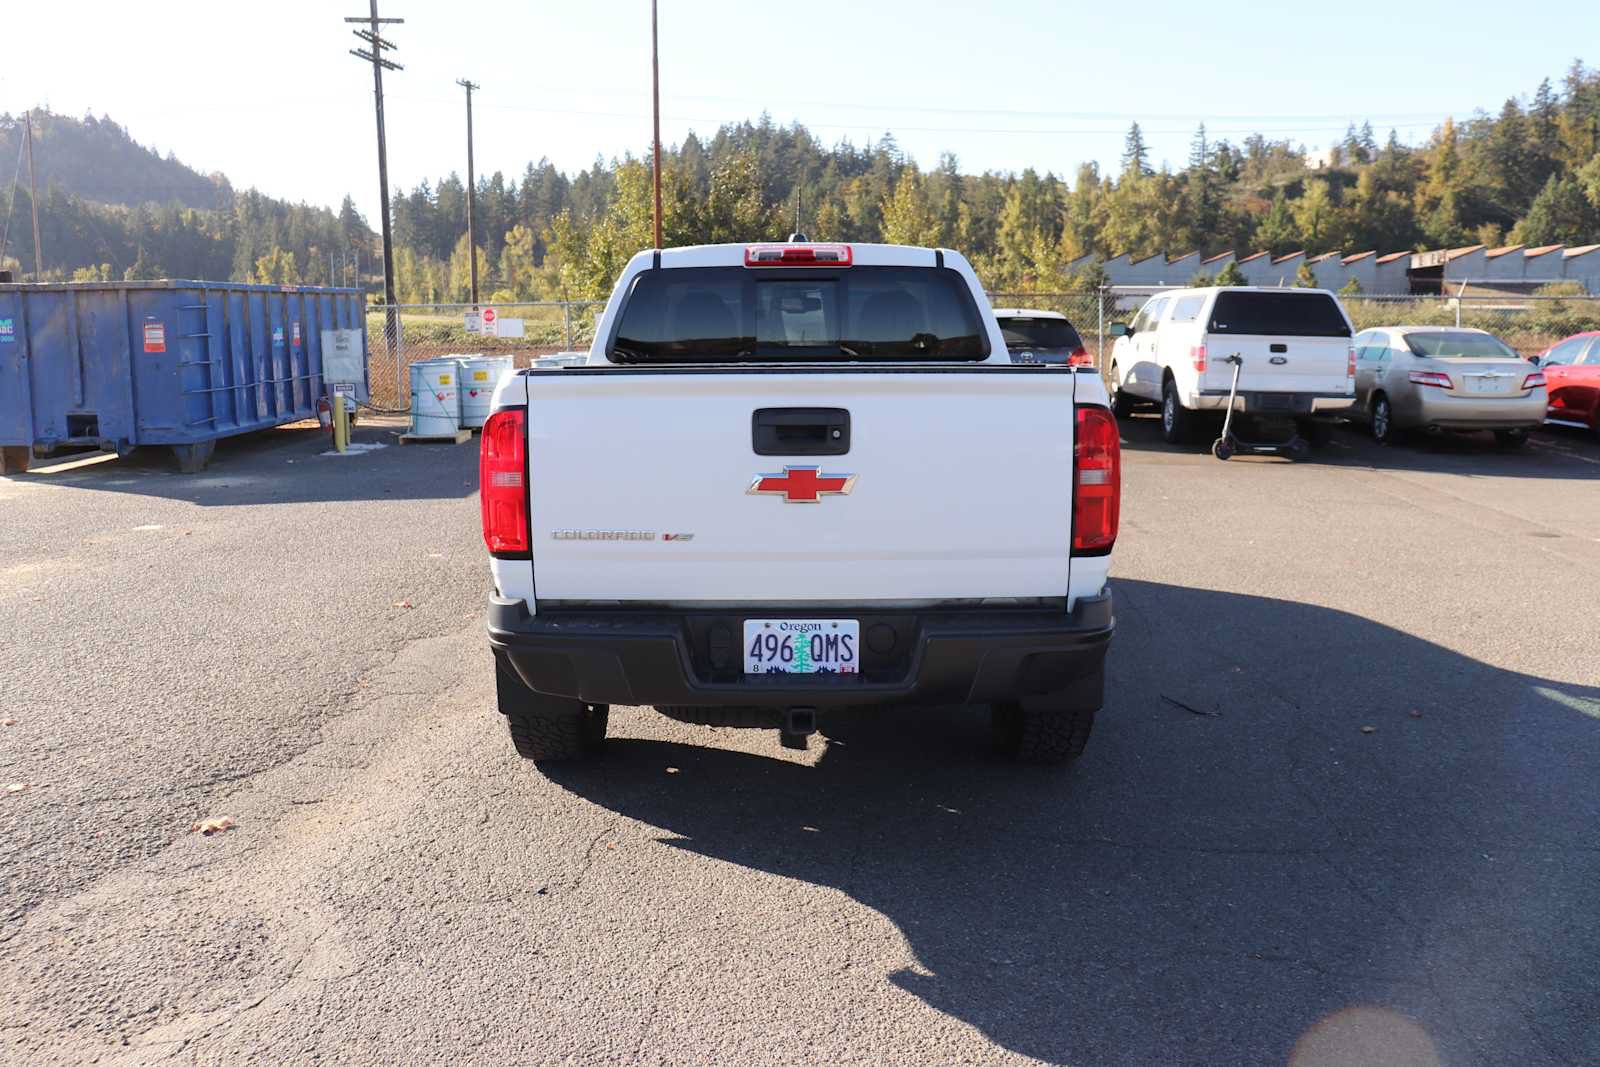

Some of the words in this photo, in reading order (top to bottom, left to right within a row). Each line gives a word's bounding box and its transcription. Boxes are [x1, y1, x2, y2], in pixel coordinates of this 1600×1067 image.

[551, 529, 656, 541] COLORADO
[780, 622, 821, 633] Oregon
[750, 634, 794, 662] 496
[810, 634, 853, 662] QMS
